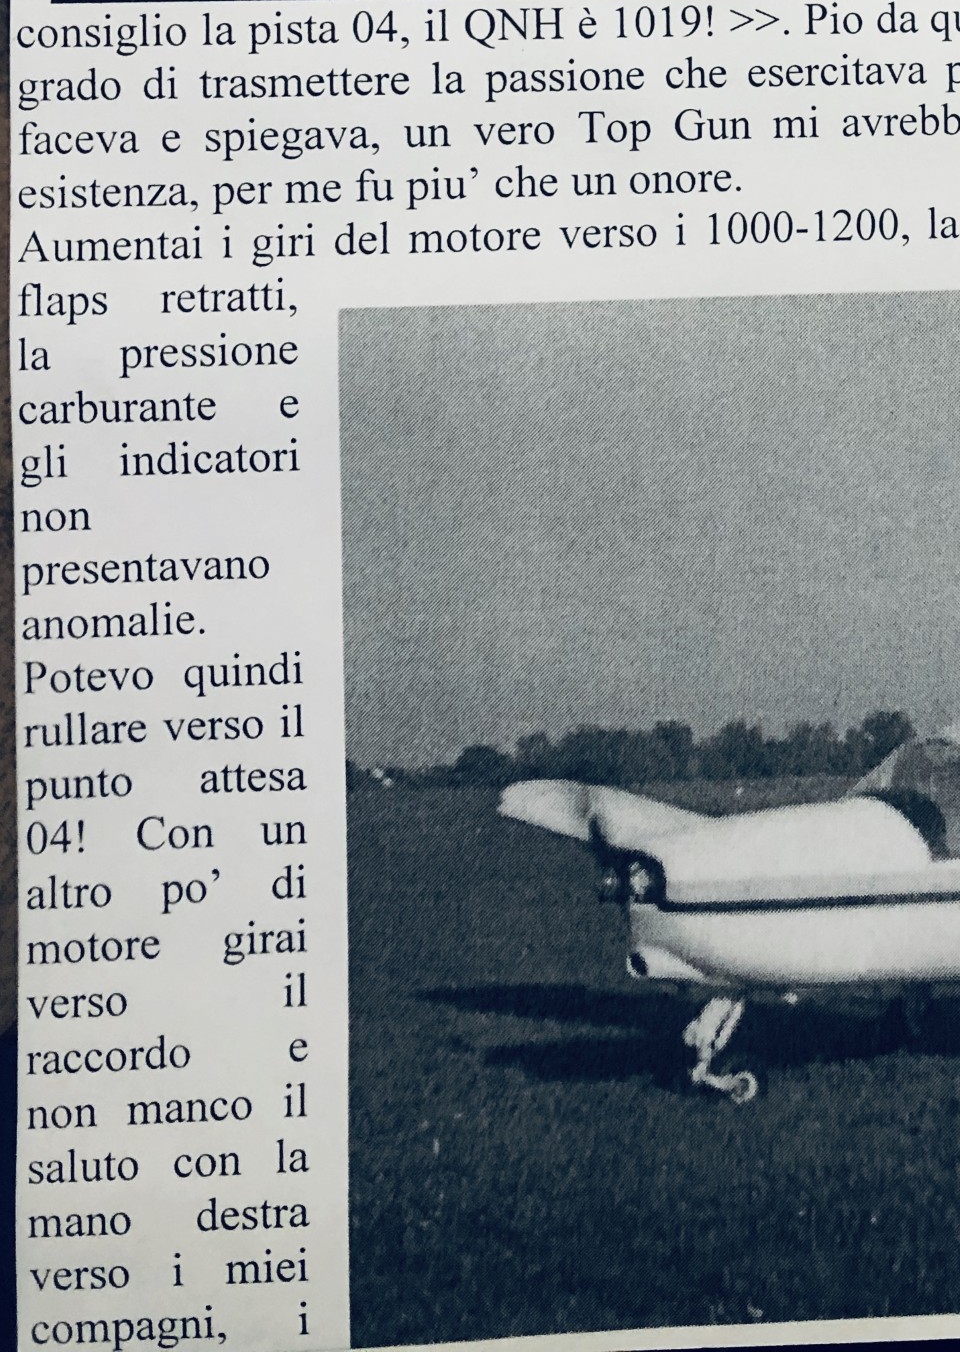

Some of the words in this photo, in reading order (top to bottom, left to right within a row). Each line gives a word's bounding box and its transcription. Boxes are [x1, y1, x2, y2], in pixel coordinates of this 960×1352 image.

[18, 67, 122, 111] grado
[143, 65, 179, 100] di
[198, 67, 410, 100] trasmettere
[431, 61, 466, 95] la
[484, 57, 645, 103] passione
[665, 55, 728, 90] che
[747, 53, 928, 88] esercitava
[21, 121, 140, 156] faceva
[161, 129, 181, 153] e
[205, 117, 380, 162] spiegava,
[403, 124, 452, 149] un
[472, 121, 555, 146] vero
[577, 110, 652, 152] Top
[674, 108, 753, 142] Gun
[772, 104, 820, 139] mi
[19, 389, 217, 425] carburante
[279, 395, 300, 419] e
[21, 443, 68, 488] gli
[119, 437, 301, 477] indicatori
[23, 553, 270, 596] presentavano
[23, 600, 206, 641] anomalie.
[26, 661, 154, 694] Potevo
[183, 650, 304, 698] quindi
[26, 711, 147, 747] rullare
[162, 715, 264, 742] verso
[279, 703, 305, 738] il
[27, 768, 133, 811] punto
[200, 763, 308, 795] attesa
[27, 819, 85, 855] 04!
[136, 815, 215, 852] Con
[259, 820, 308, 846] un
[28, 932, 161, 965] motore
[222, 917, 308, 967] girai
[27, 1034, 192, 1075] raccordo
[288, 1038, 309, 1063] e
[28, 1148, 139, 1185] saluto
[173, 1152, 242, 1179] con
[275, 1138, 310, 1174] la
[28, 1211, 132, 1239] mano
[196, 1196, 311, 1233] destra
